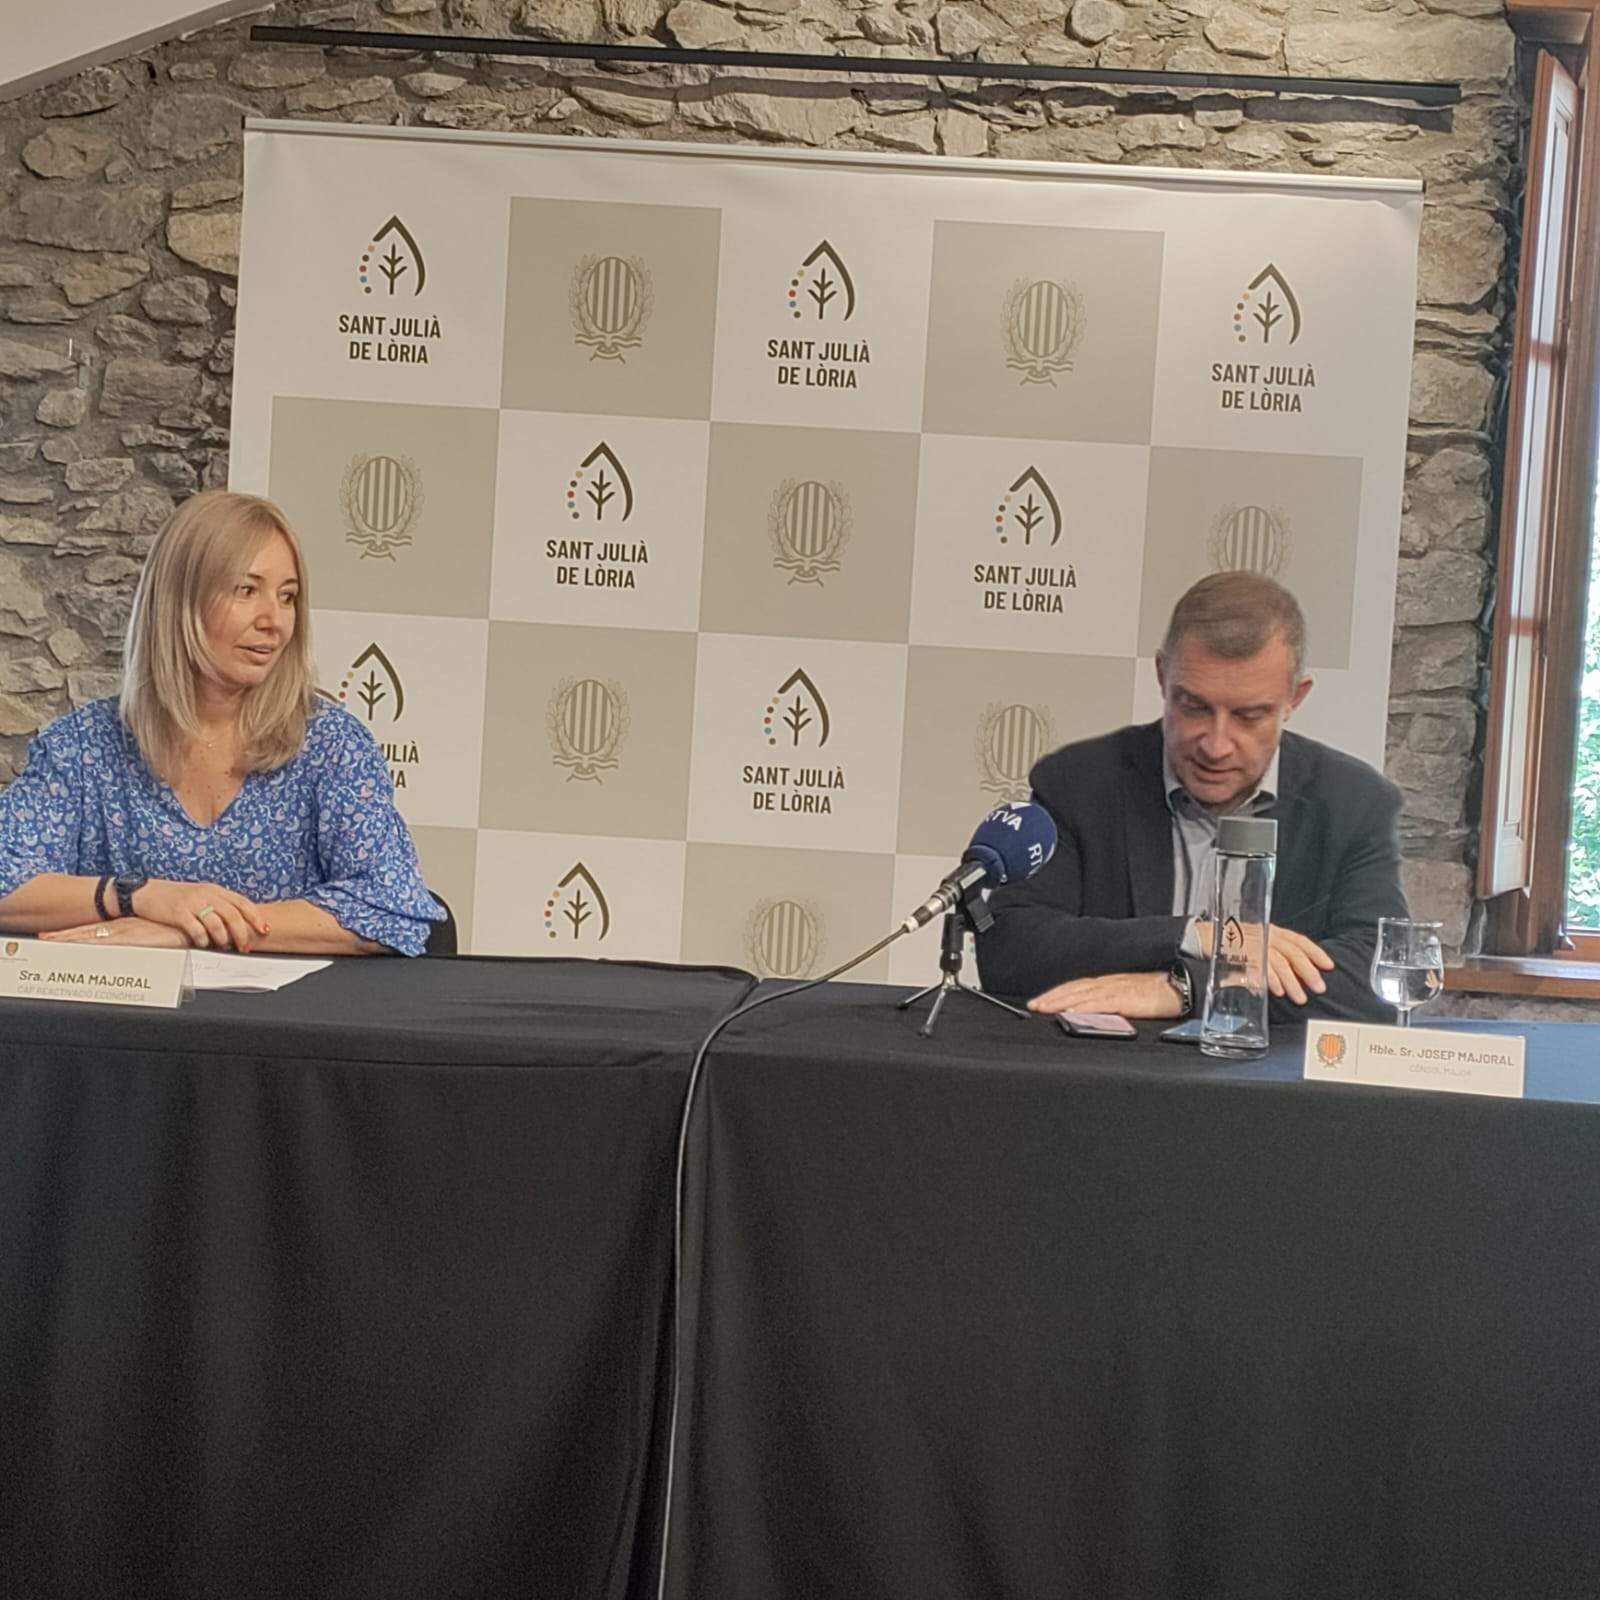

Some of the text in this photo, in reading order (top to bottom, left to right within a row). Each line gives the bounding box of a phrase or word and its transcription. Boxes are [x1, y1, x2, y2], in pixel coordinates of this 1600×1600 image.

[338, 314, 441, 339] SANT JULIÀ
[349, 338, 429, 364] DE LÒRIA
[767, 338, 870, 364] SANT JULIÀ
[777, 363, 857, 389] DE LÒRIA
[1211, 363, 1316, 387] SANT JULIÀ
[1221, 387, 1302, 413] DE LÒRIA
[546, 539, 649, 564] SANT JULIÀ
[556, 563, 636, 589] DE LÒRIA
[973, 564, 1077, 589] SANT JULIÀ
[984, 587, 1064, 614] DE LÒRIA
[381, 740, 419, 764] ULIÀ
[742, 765, 845, 790] SANT JULIÀ
[753, 789, 832, 815] DE LÒRIA
[19, 970, 152, 990] Sra. ANNA MAJORAL
[1369, 1044, 1515, 1067] Hble. Sr. JOSEP MAJORAL
